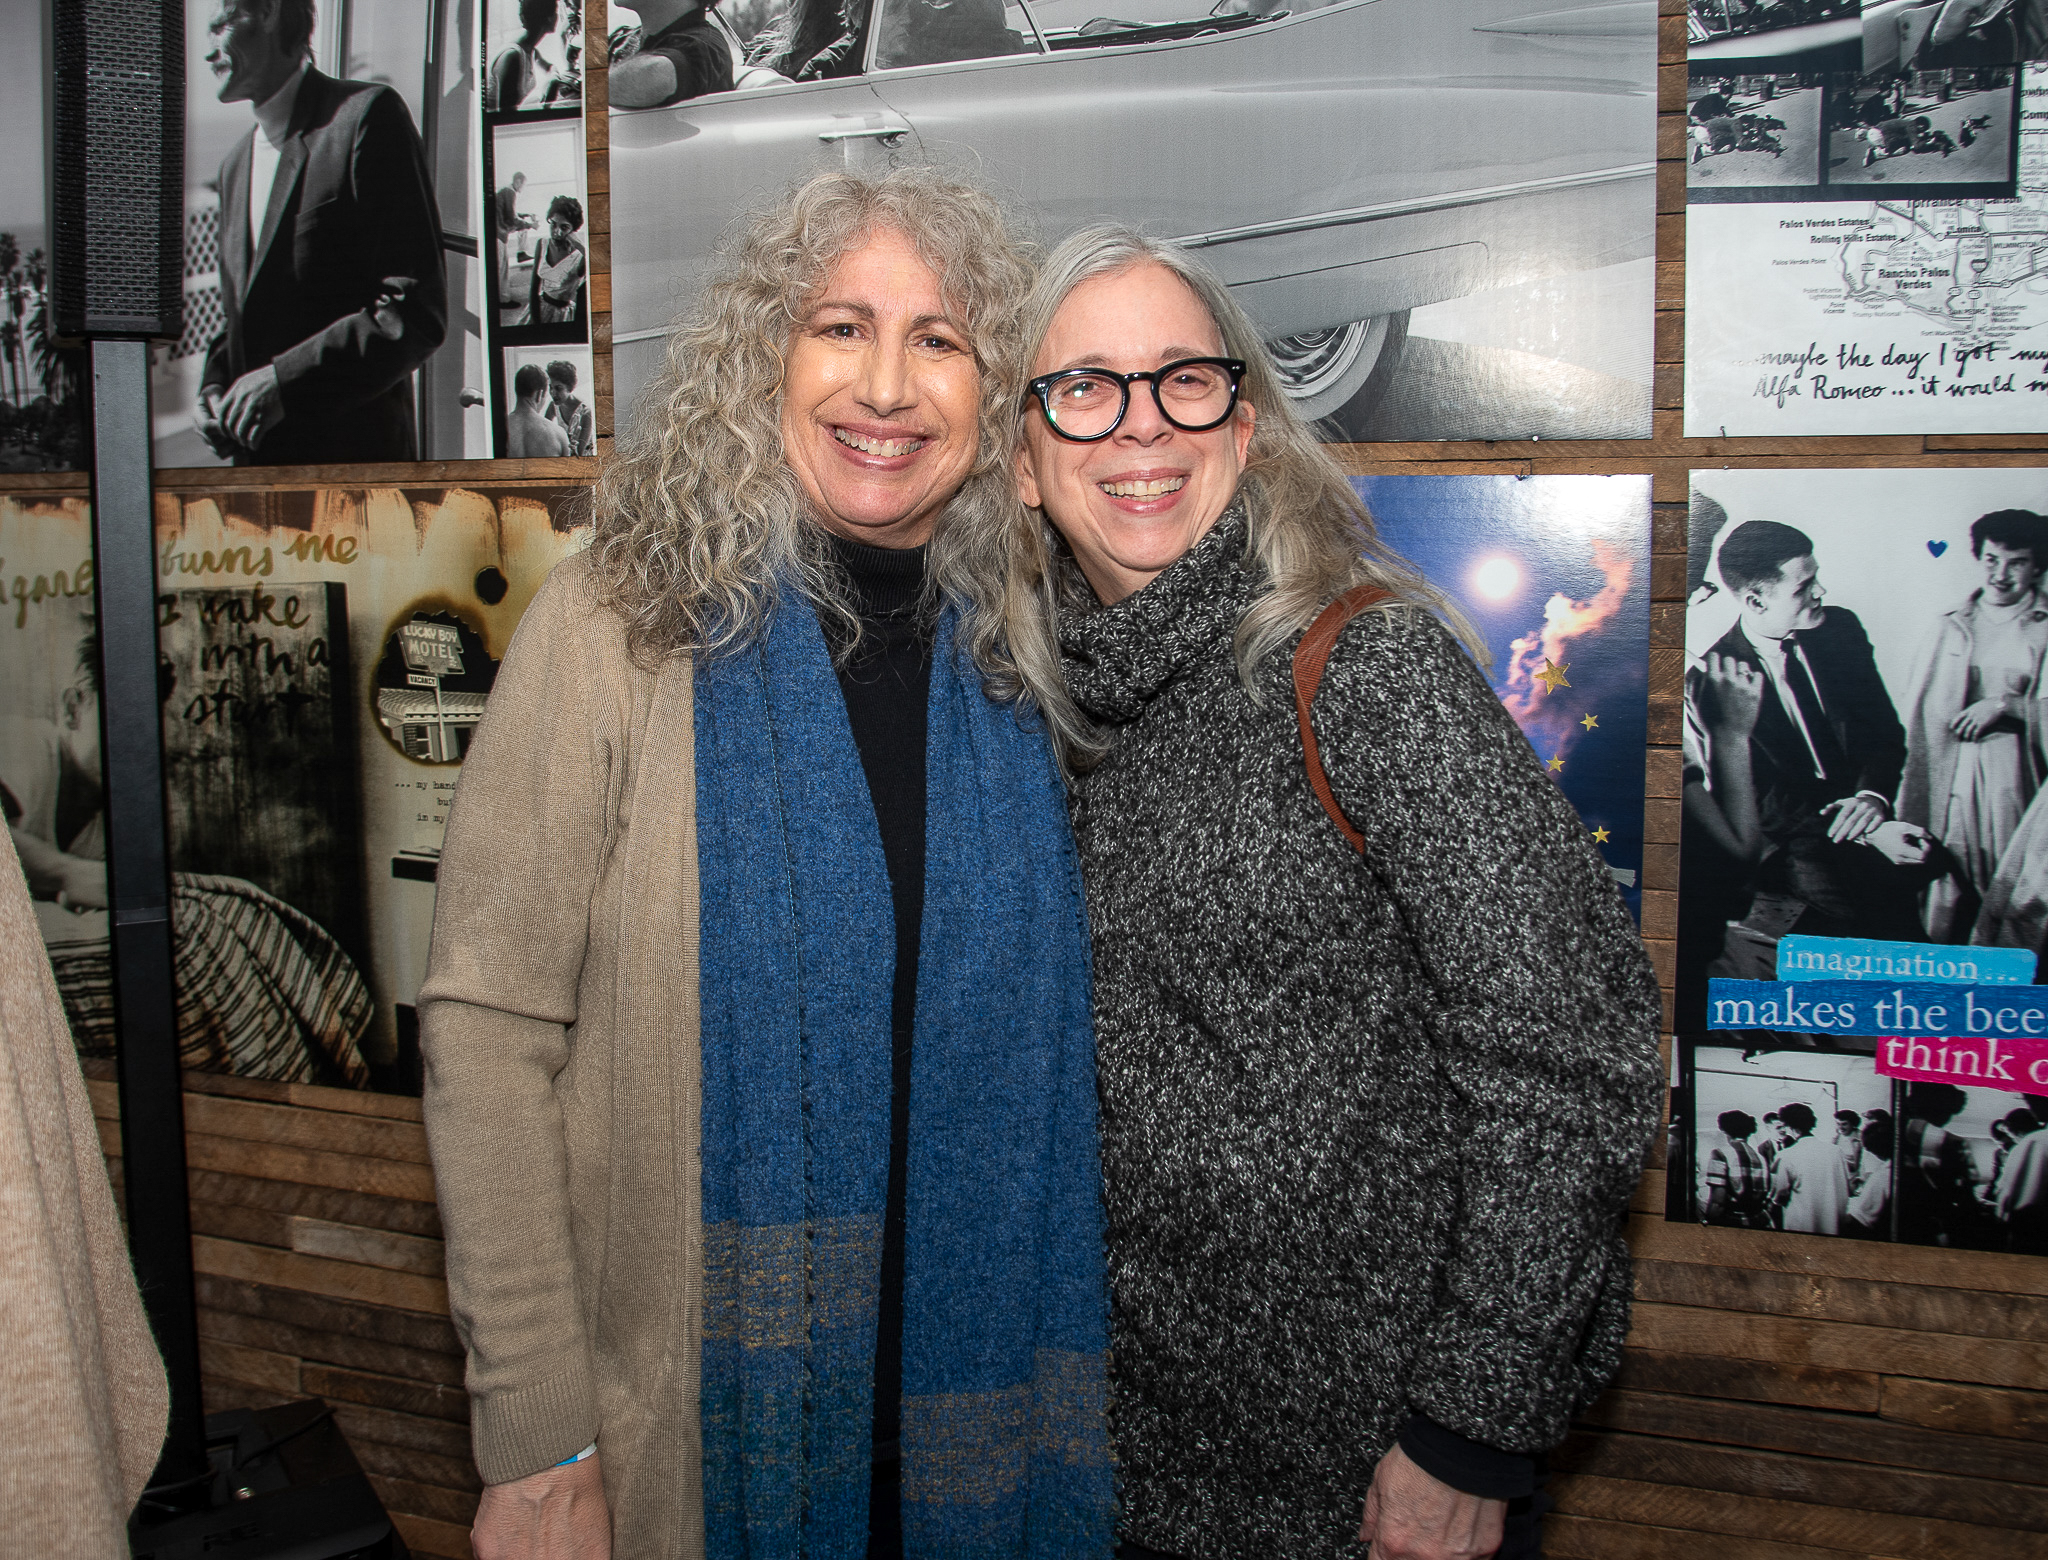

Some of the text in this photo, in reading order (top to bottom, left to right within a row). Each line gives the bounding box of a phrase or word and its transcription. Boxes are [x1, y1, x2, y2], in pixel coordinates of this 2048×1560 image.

[1780, 219, 1803, 228] Palos
[1805, 219, 1835, 227] Verdes
[1838, 218, 1870, 226] Estates
[1809, 233, 1897, 244] Rolling Hills Estates
[1878, 267, 1951, 279] Rancho Palos
[1895, 279, 1933, 289] Verdes
[1836, 342, 1875, 370] the
[1881, 342, 1930, 379] day
[1939, 342, 1947, 366] I
[1955, 341, 2001, 378] got
[1752, 374, 1802, 409] Alfa
[1944, 373, 2016, 398] would
[161, 530, 274, 576] burns
[283, 533, 359, 565] me
[197, 580, 312, 630] wake
[404, 624, 458, 643] LUCKY BOY
[307, 637, 331, 667] a
[409, 639, 455, 659] MOTEL
[409, 674, 436, 685] VACANCY
[183, 679, 314, 737] start
[416, 781, 428, 791] my
[416, 812, 446, 824] in my
[1713, 985, 1857, 1029] makes
[1873, 989, 1949, 1032] the
[1885, 1036, 2016, 1081] think
